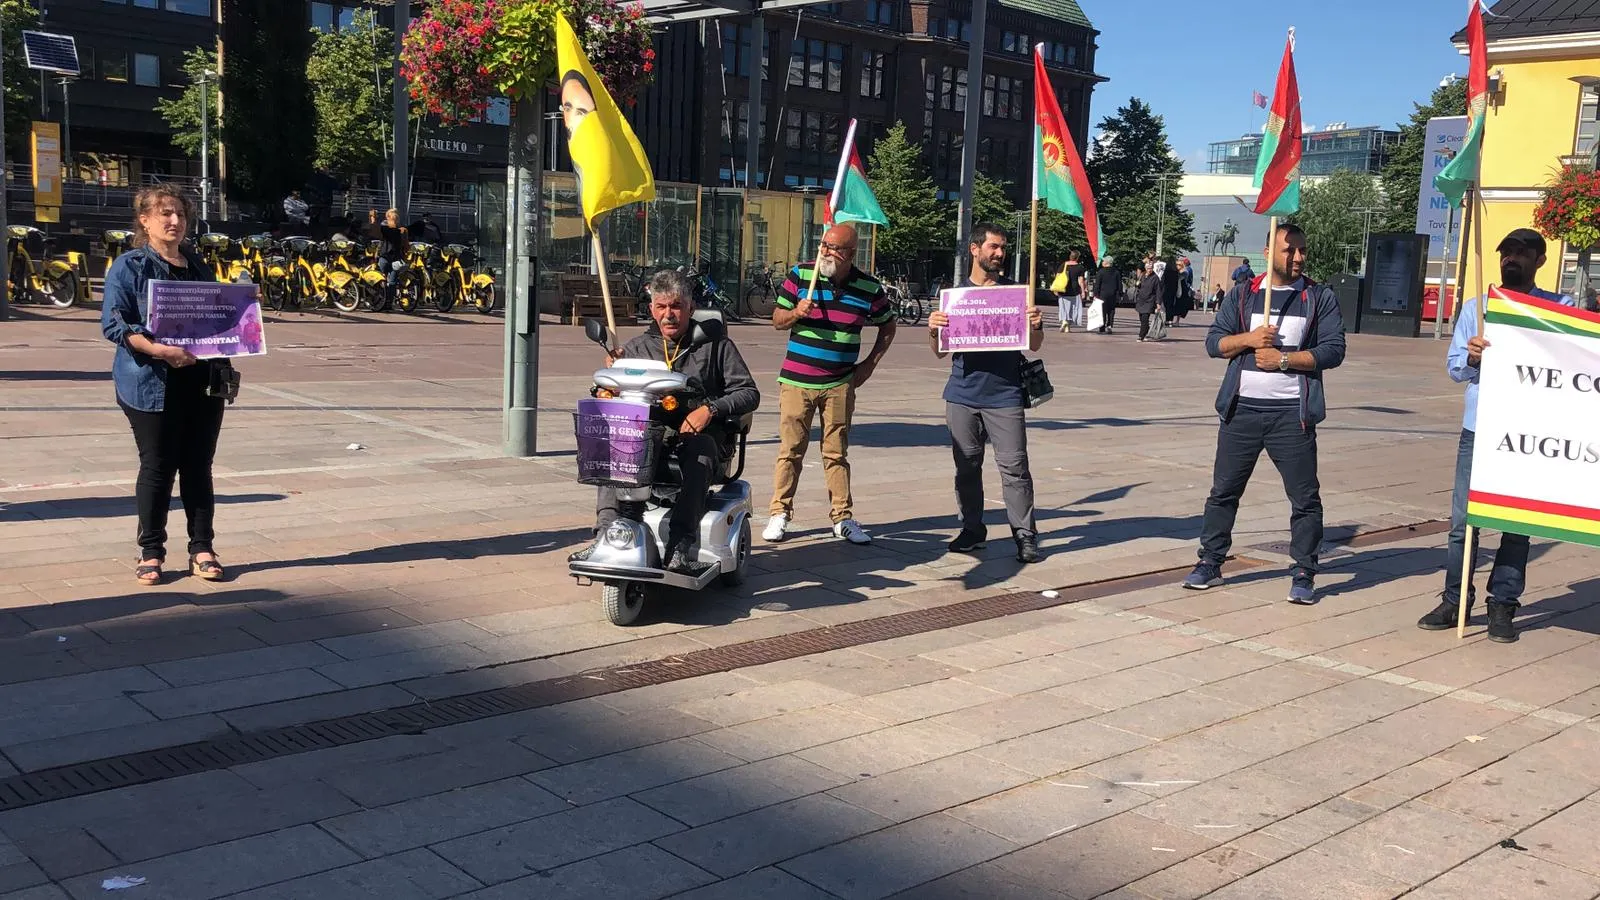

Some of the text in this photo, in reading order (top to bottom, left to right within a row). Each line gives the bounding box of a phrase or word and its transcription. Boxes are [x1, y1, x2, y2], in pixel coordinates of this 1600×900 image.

[977, 306, 1020, 315] GENOCIDE
[195, 335, 240, 345] UNOHTAA!
[949, 334, 1020, 344] NEVER FORGET!
[1515, 365, 1563, 390] WE
[584, 425, 616, 436] SINJAR
[1496, 432, 1600, 464] AUGUS
[584, 461, 617, 471] NEVER
